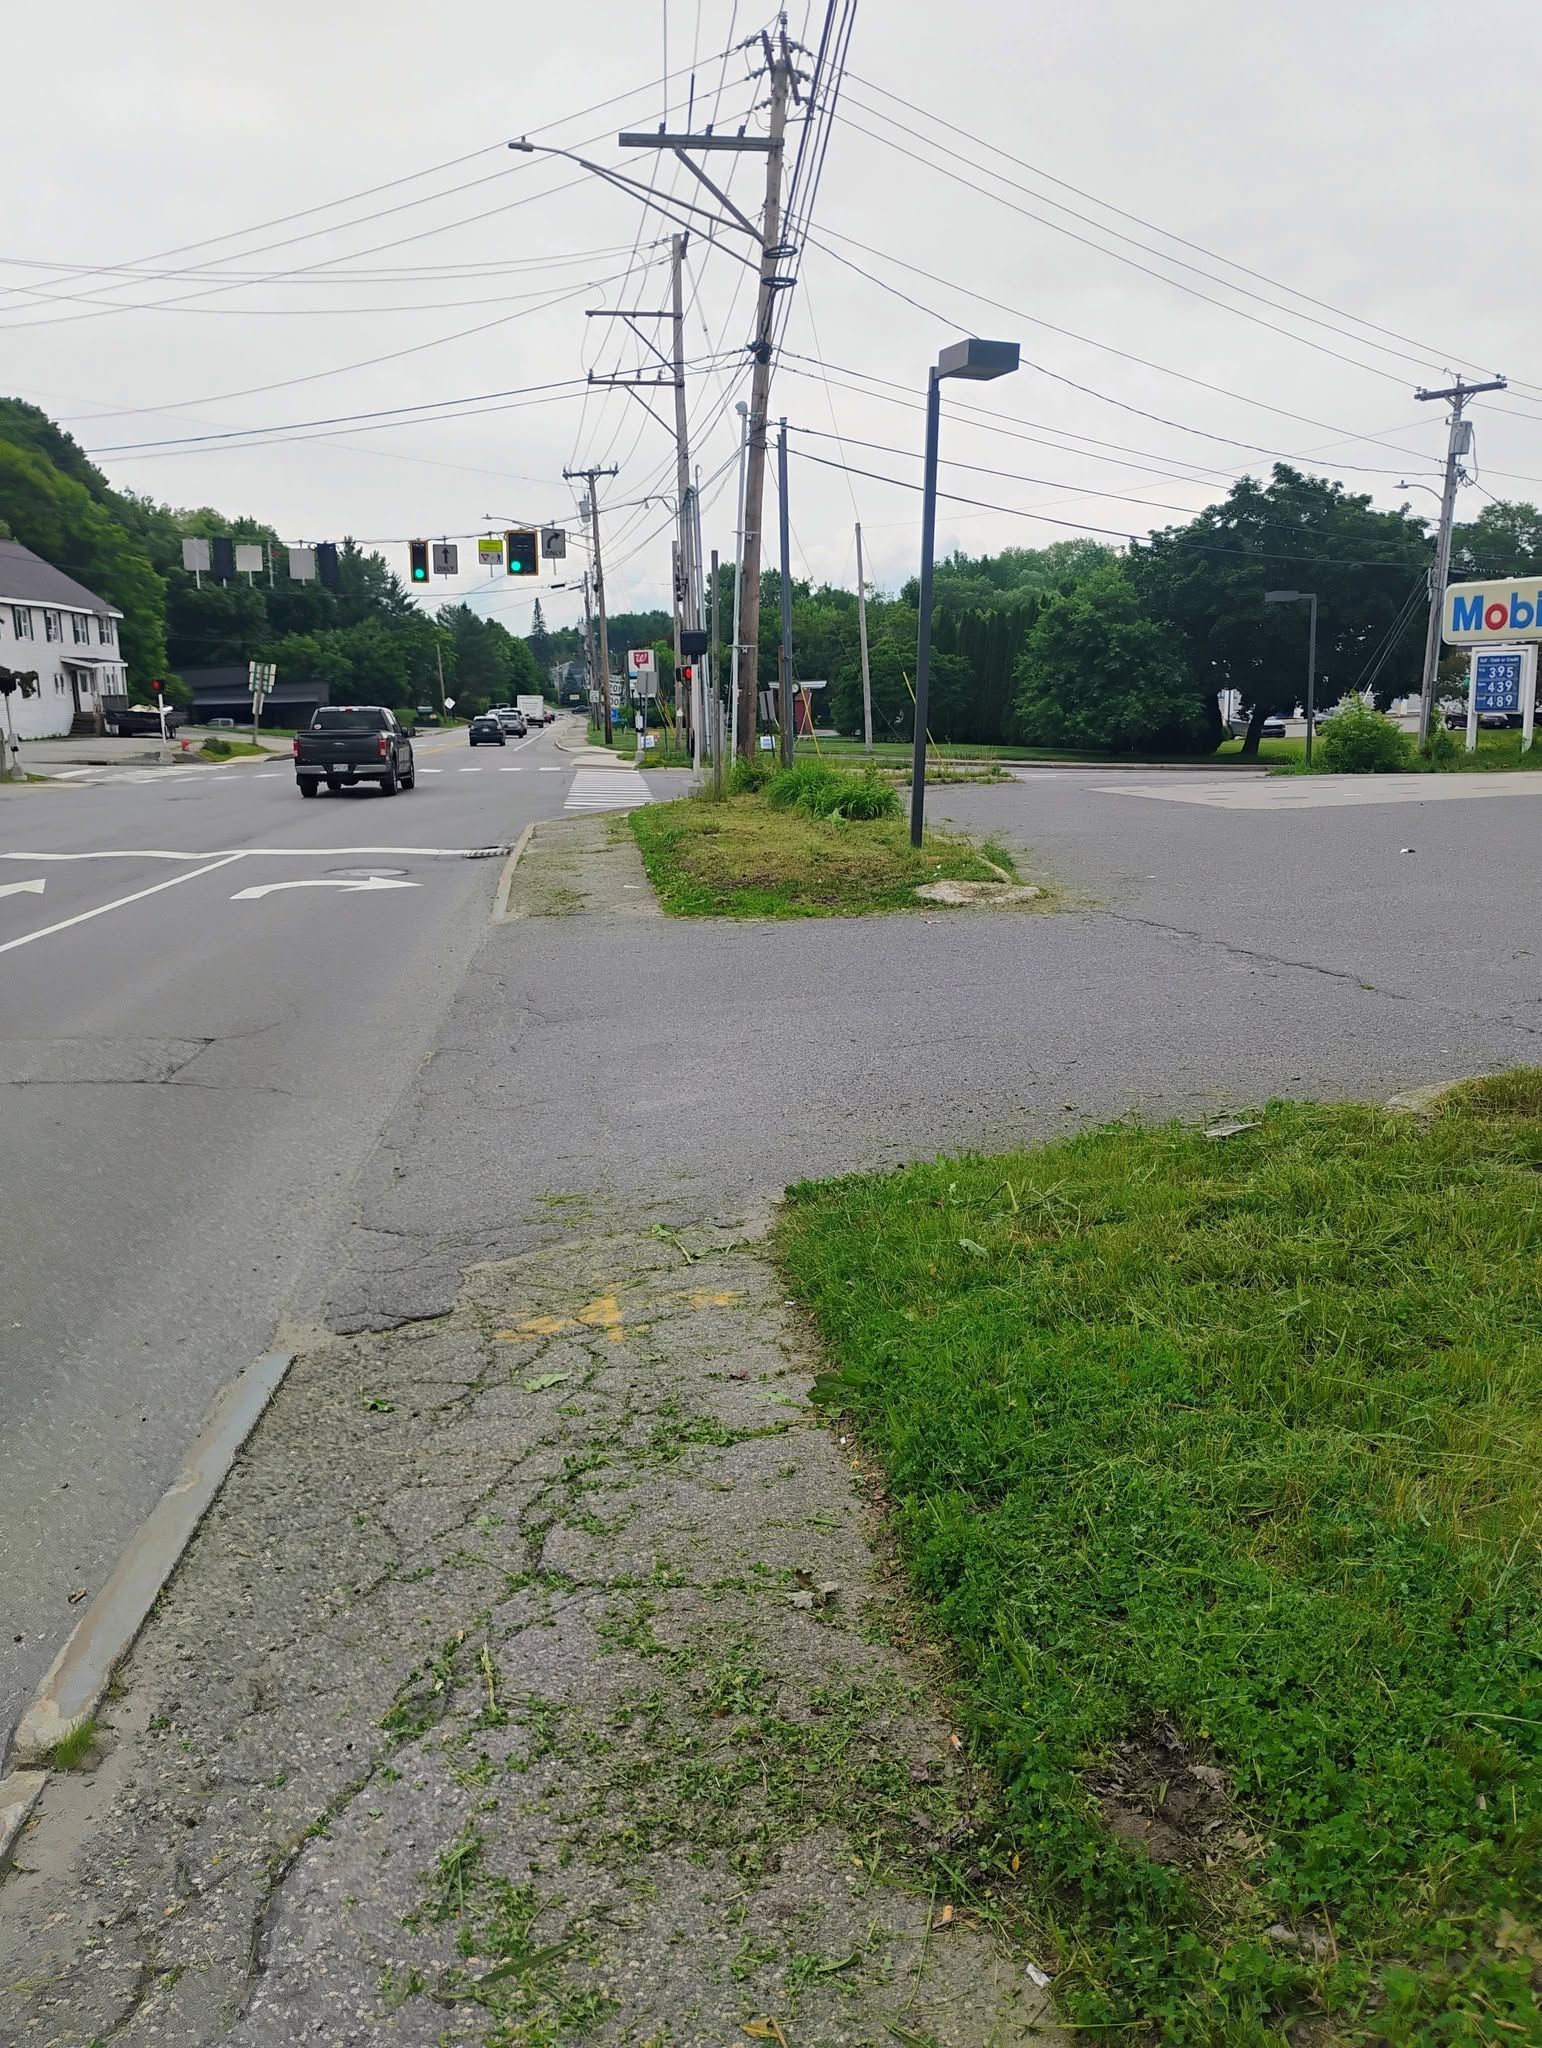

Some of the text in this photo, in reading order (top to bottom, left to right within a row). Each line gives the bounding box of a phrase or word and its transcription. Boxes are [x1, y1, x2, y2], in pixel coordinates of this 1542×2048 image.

[1489, 665, 1514, 678] 395
[1487, 680, 1513, 693] 439
[1486, 694, 1513, 707] 489
